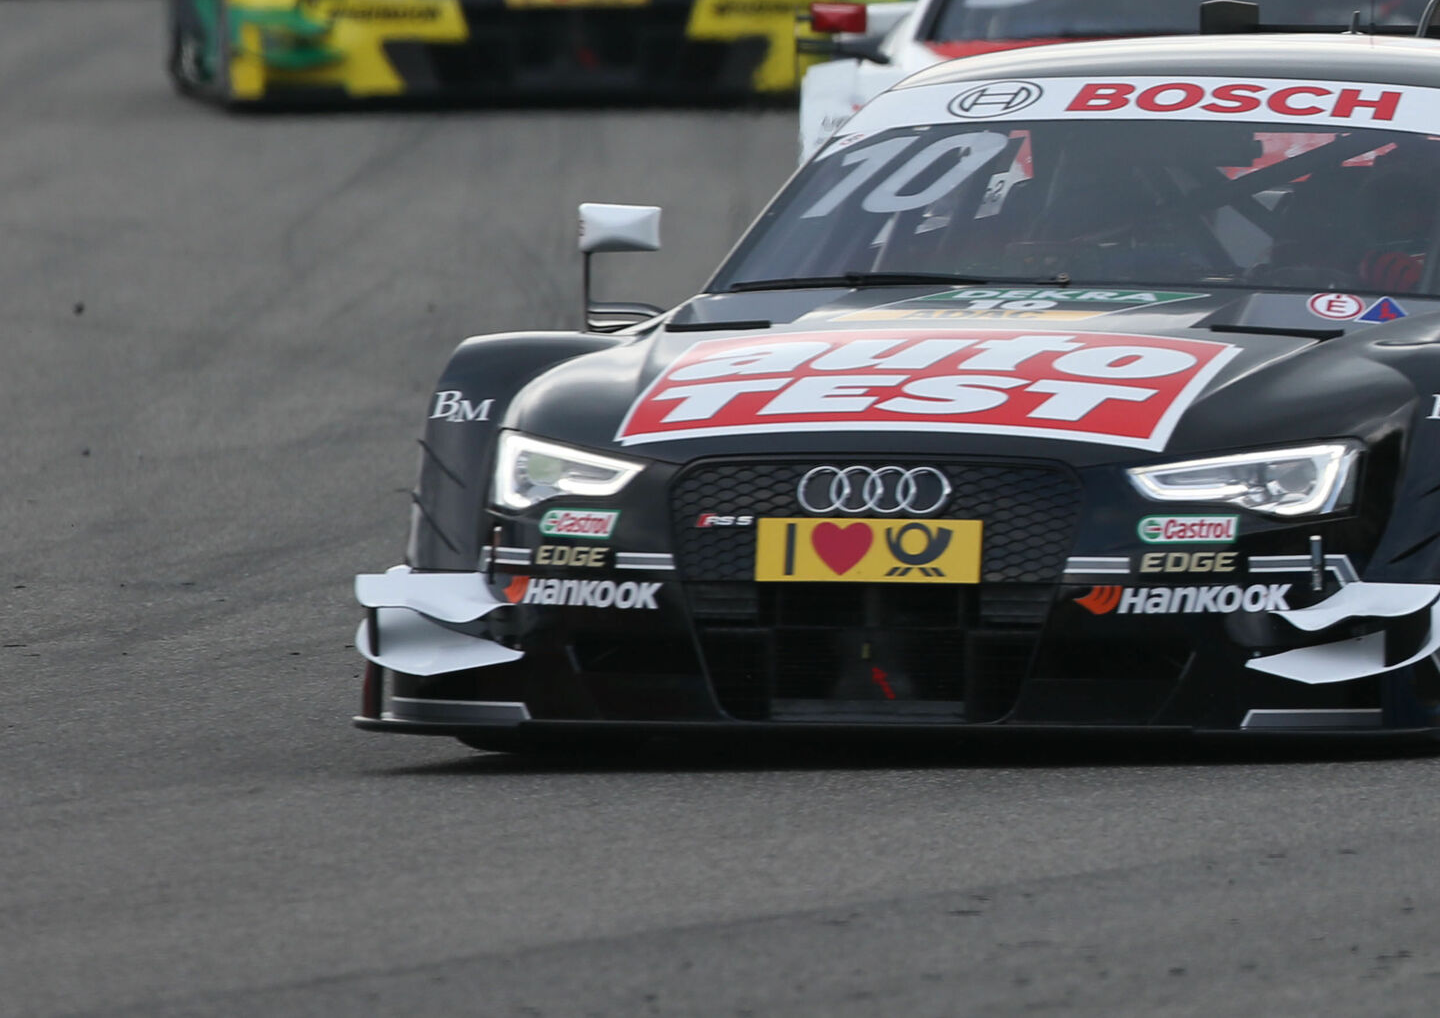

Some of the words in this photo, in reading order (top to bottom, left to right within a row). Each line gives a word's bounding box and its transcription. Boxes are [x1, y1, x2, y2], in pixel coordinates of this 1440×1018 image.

[1064, 82, 1403, 122] BOSCH
[800, 131, 1009, 218] 10
[953, 290, 1158, 302] DEKRA
[968, 300, 1058, 310] 10
[667, 334, 1197, 380] auto
[652, 375, 1160, 424] TEST
[557, 513, 610, 533] Castrol
[1164, 519, 1233, 539] Castrol
[535, 545, 610, 567] EDGE
[1140, 552, 1239, 573] EDGE
